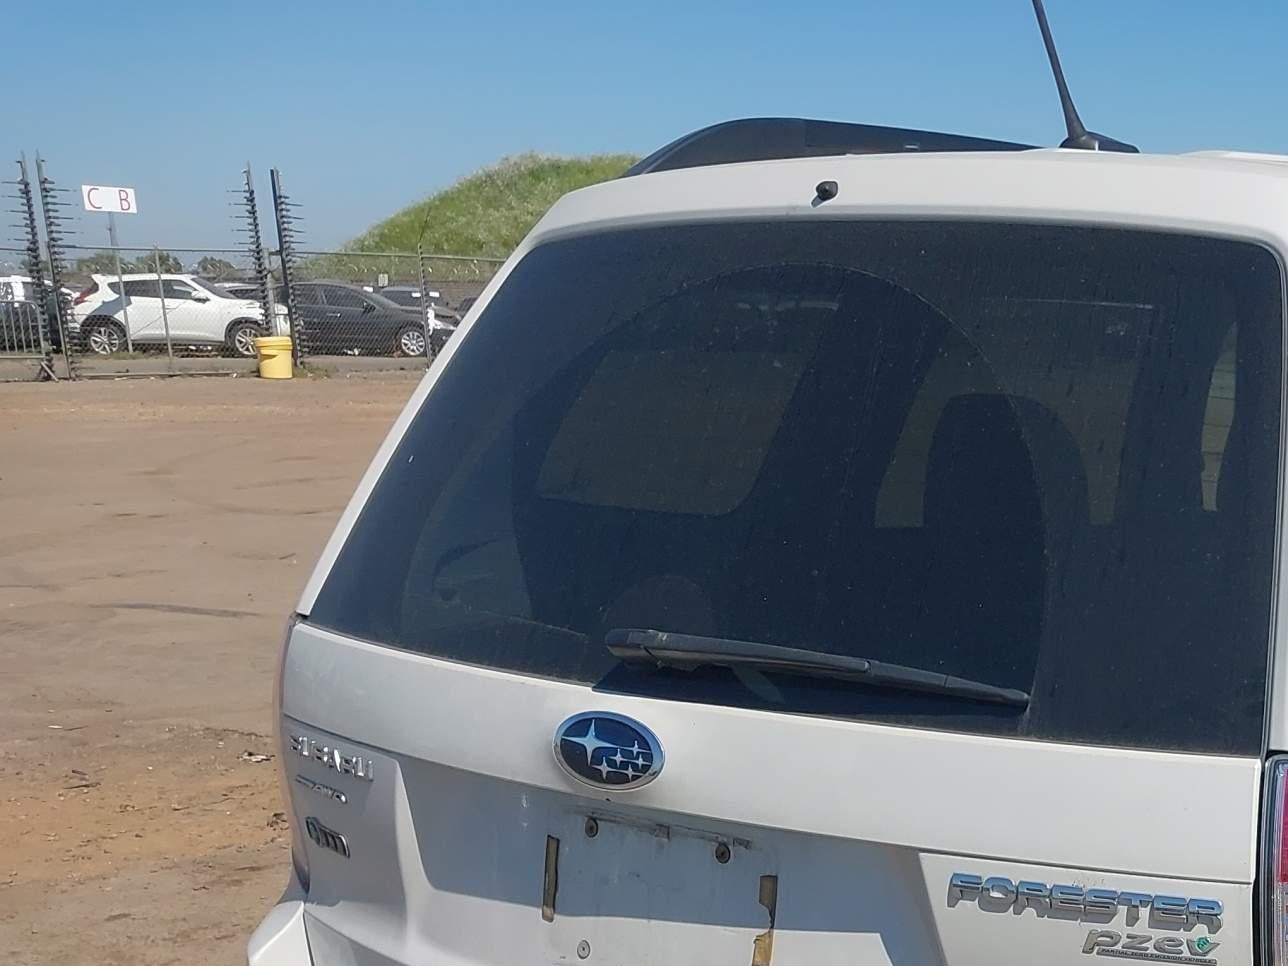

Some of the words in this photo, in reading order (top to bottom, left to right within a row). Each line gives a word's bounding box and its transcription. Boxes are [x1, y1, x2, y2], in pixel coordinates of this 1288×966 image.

[88, 188, 103, 209] C
[119, 190, 131, 211] B
[290, 735, 374, 782] SUBARU
[947, 872, 1224, 934] FORESTER
